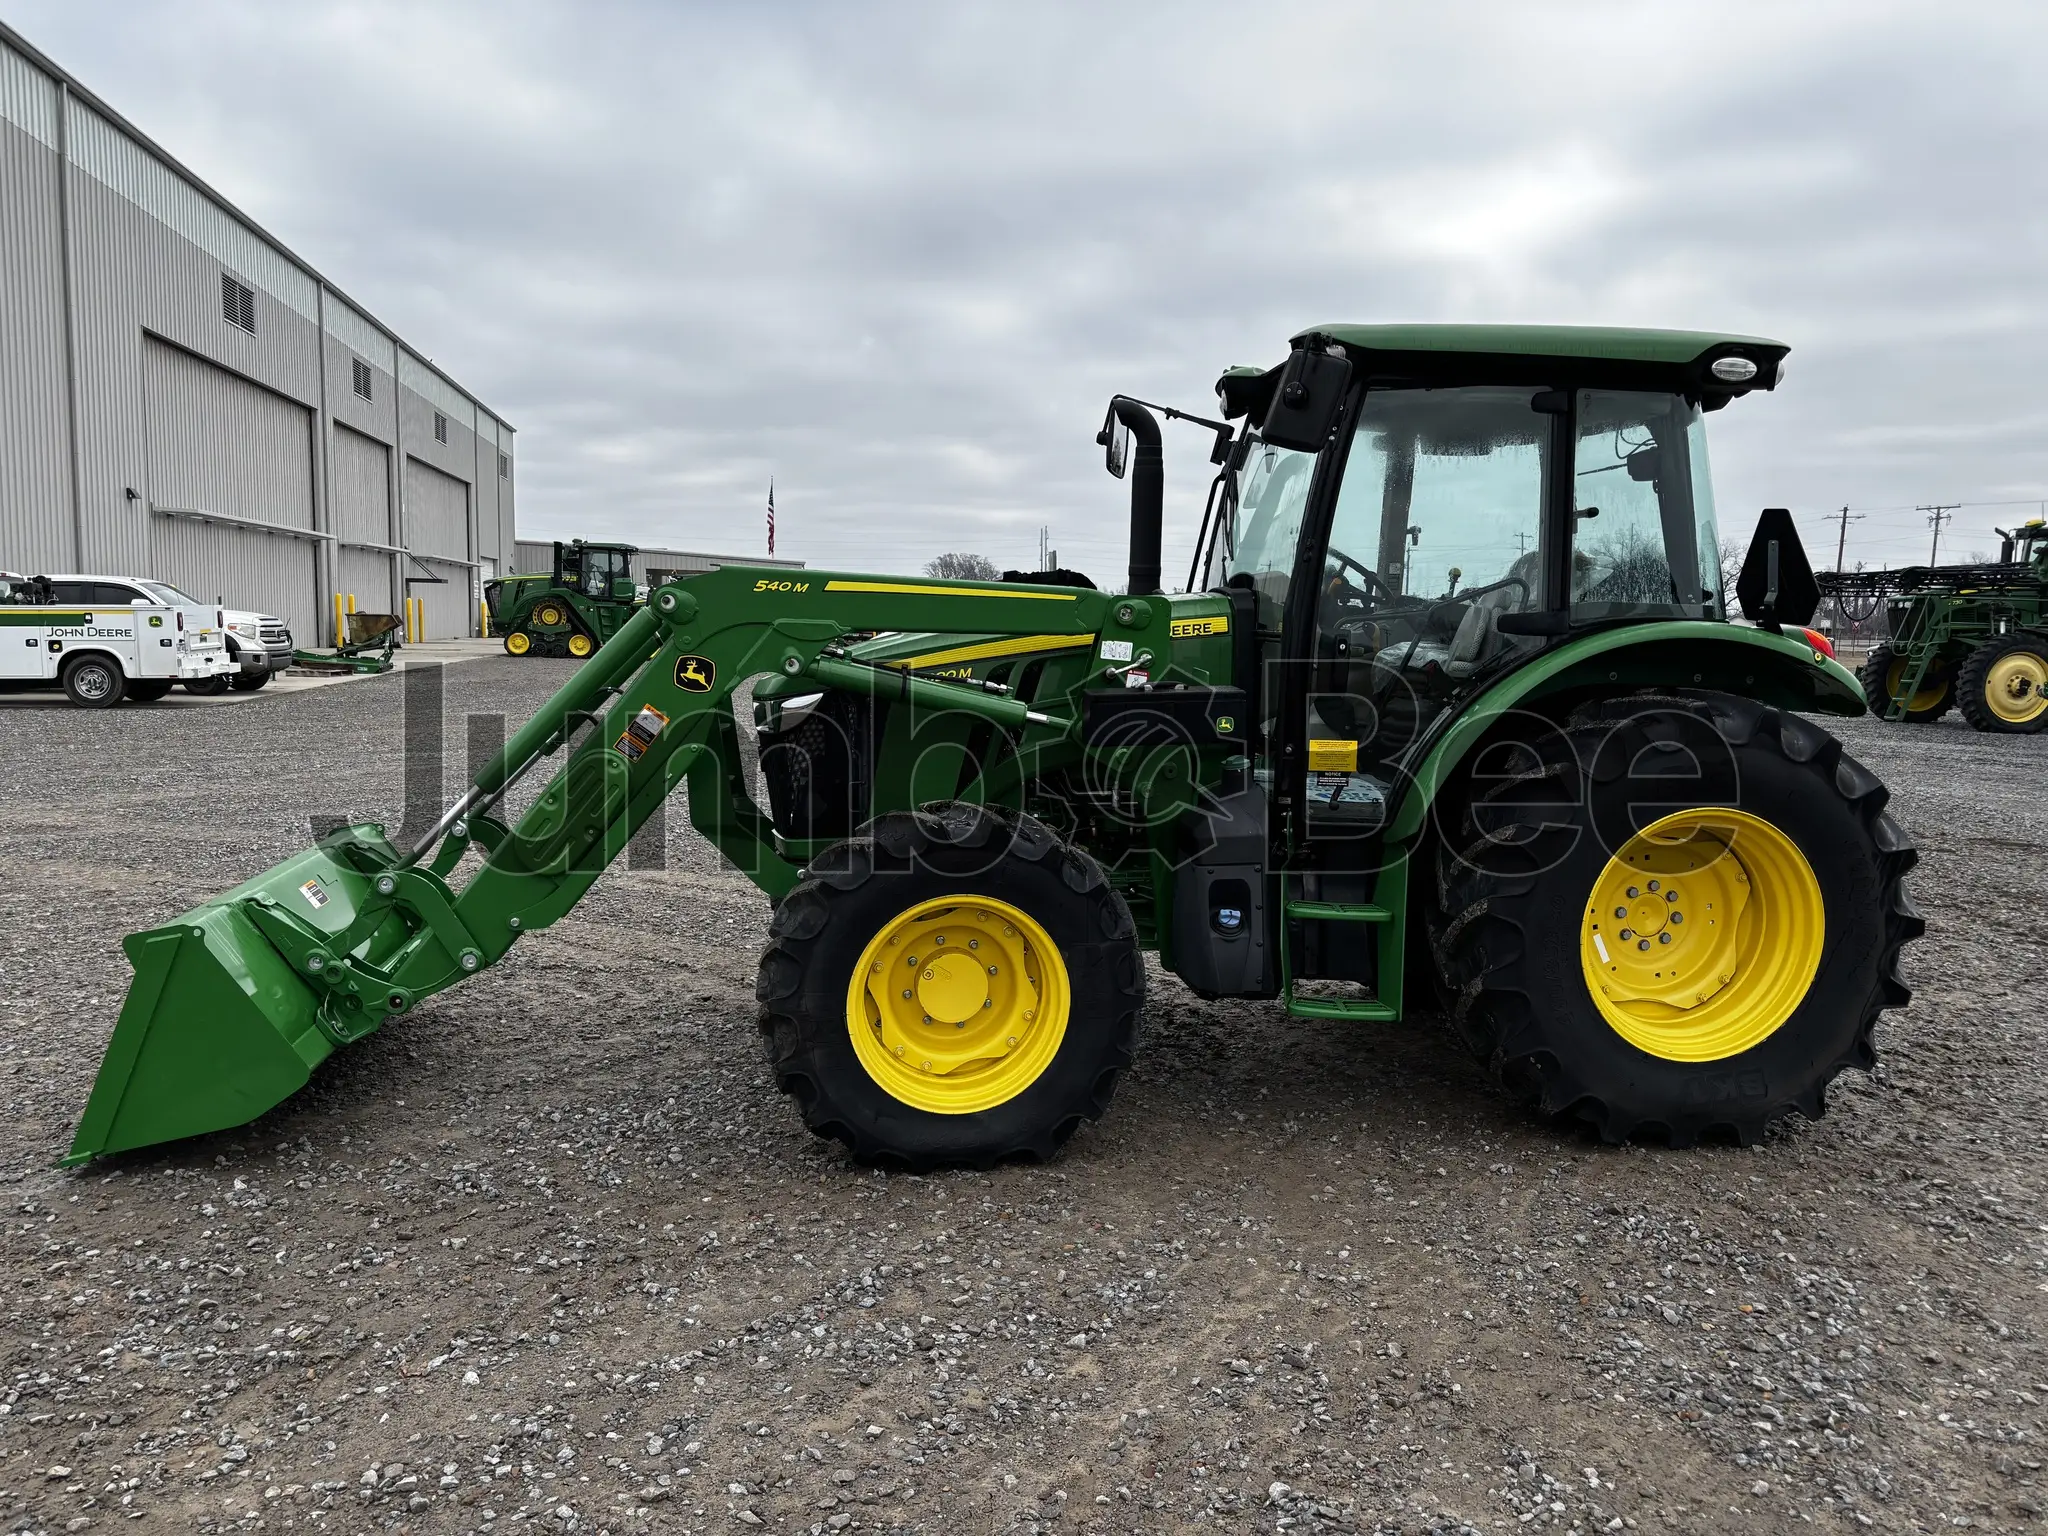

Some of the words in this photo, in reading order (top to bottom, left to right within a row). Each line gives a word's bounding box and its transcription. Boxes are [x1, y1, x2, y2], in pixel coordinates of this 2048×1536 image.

[46, 627, 84, 637] JOHN
[87, 627, 132, 637] DEERE
[1171, 622, 1213, 636] EERE
